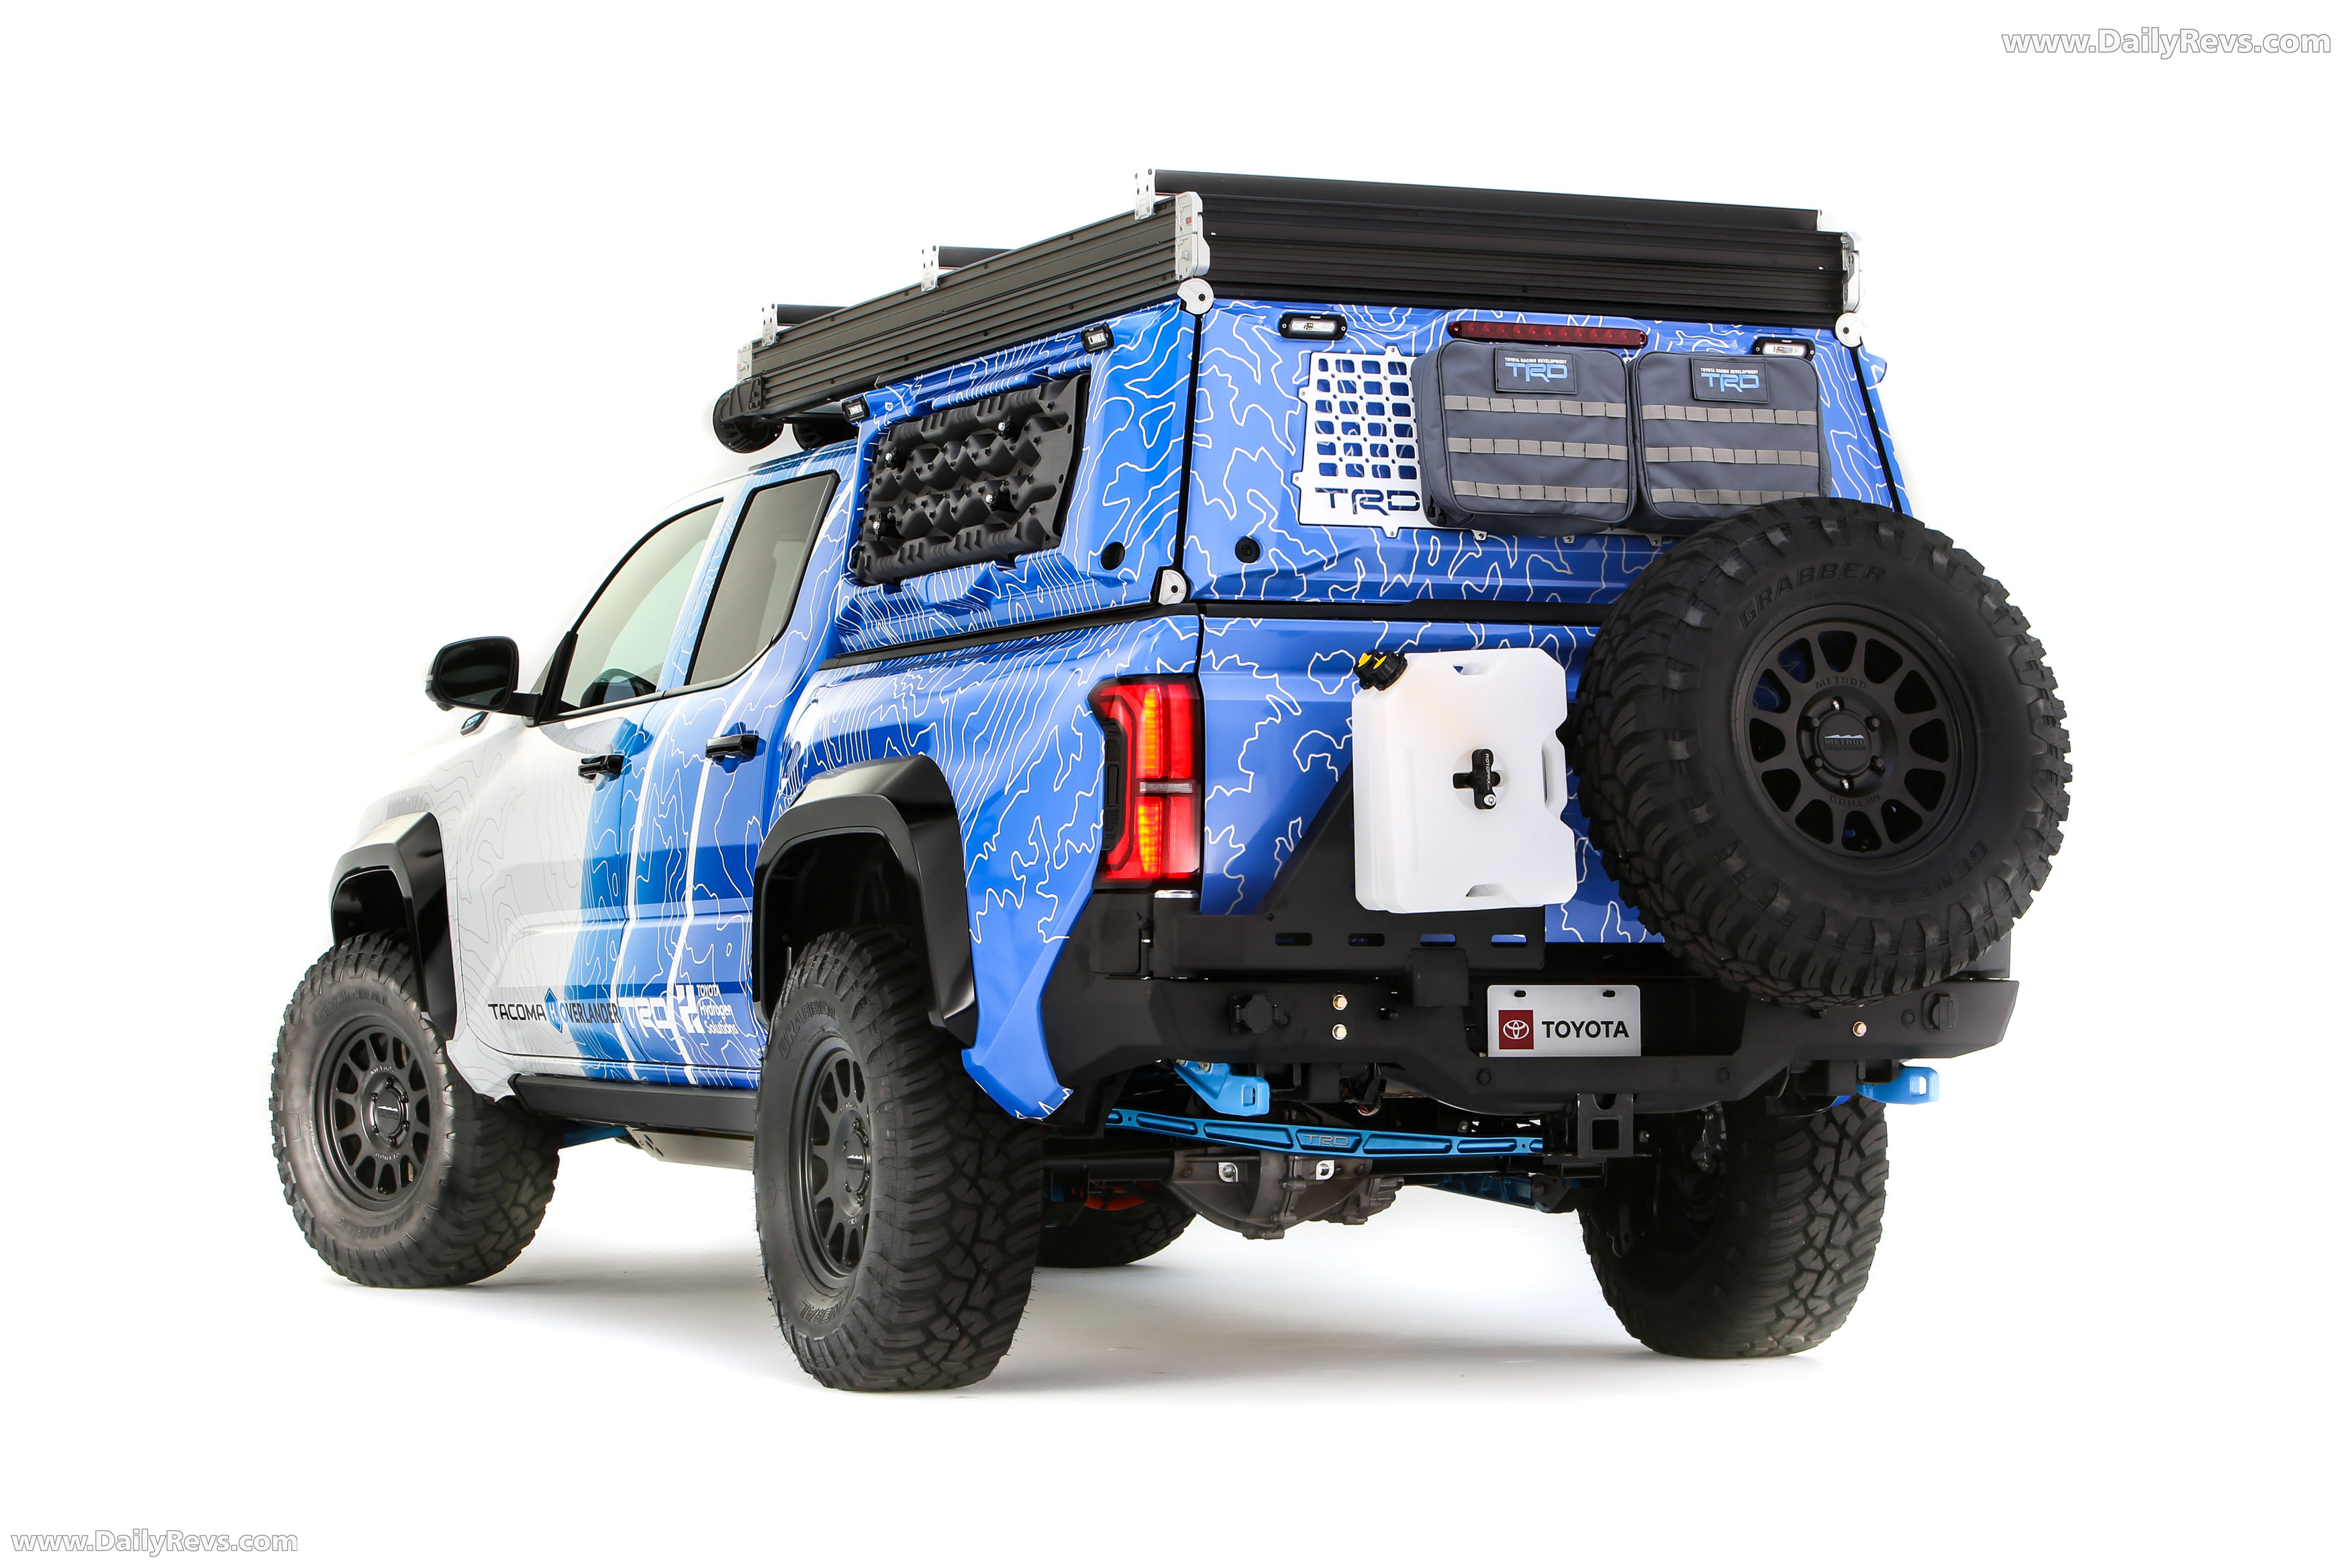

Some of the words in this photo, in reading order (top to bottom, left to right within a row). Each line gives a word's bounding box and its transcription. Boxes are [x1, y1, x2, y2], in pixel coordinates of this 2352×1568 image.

[1505, 362, 1568, 383] TRD
[1701, 373, 1760, 393] TRD
[1315, 487, 1420, 516] TRD
[1739, 562, 1888, 629] GRABBER
[1815, 676, 1867, 689] METHOD
[1842, 840, 1989, 905] GENERAL
[696, 984, 721, 997] TOYOTA
[487, 1003, 547, 1020] TACOMA
[560, 1001, 622, 1023] OVERLANDER
[618, 997, 673, 1038] TRD
[699, 1001, 733, 1020] Hydrogen
[704, 1020, 739, 1034] Solutions
[779, 999, 836, 1059] GRABBER
[1542, 1020, 1630, 1038] TOYOTA
[1304, 1134, 1349, 1147] TRD
